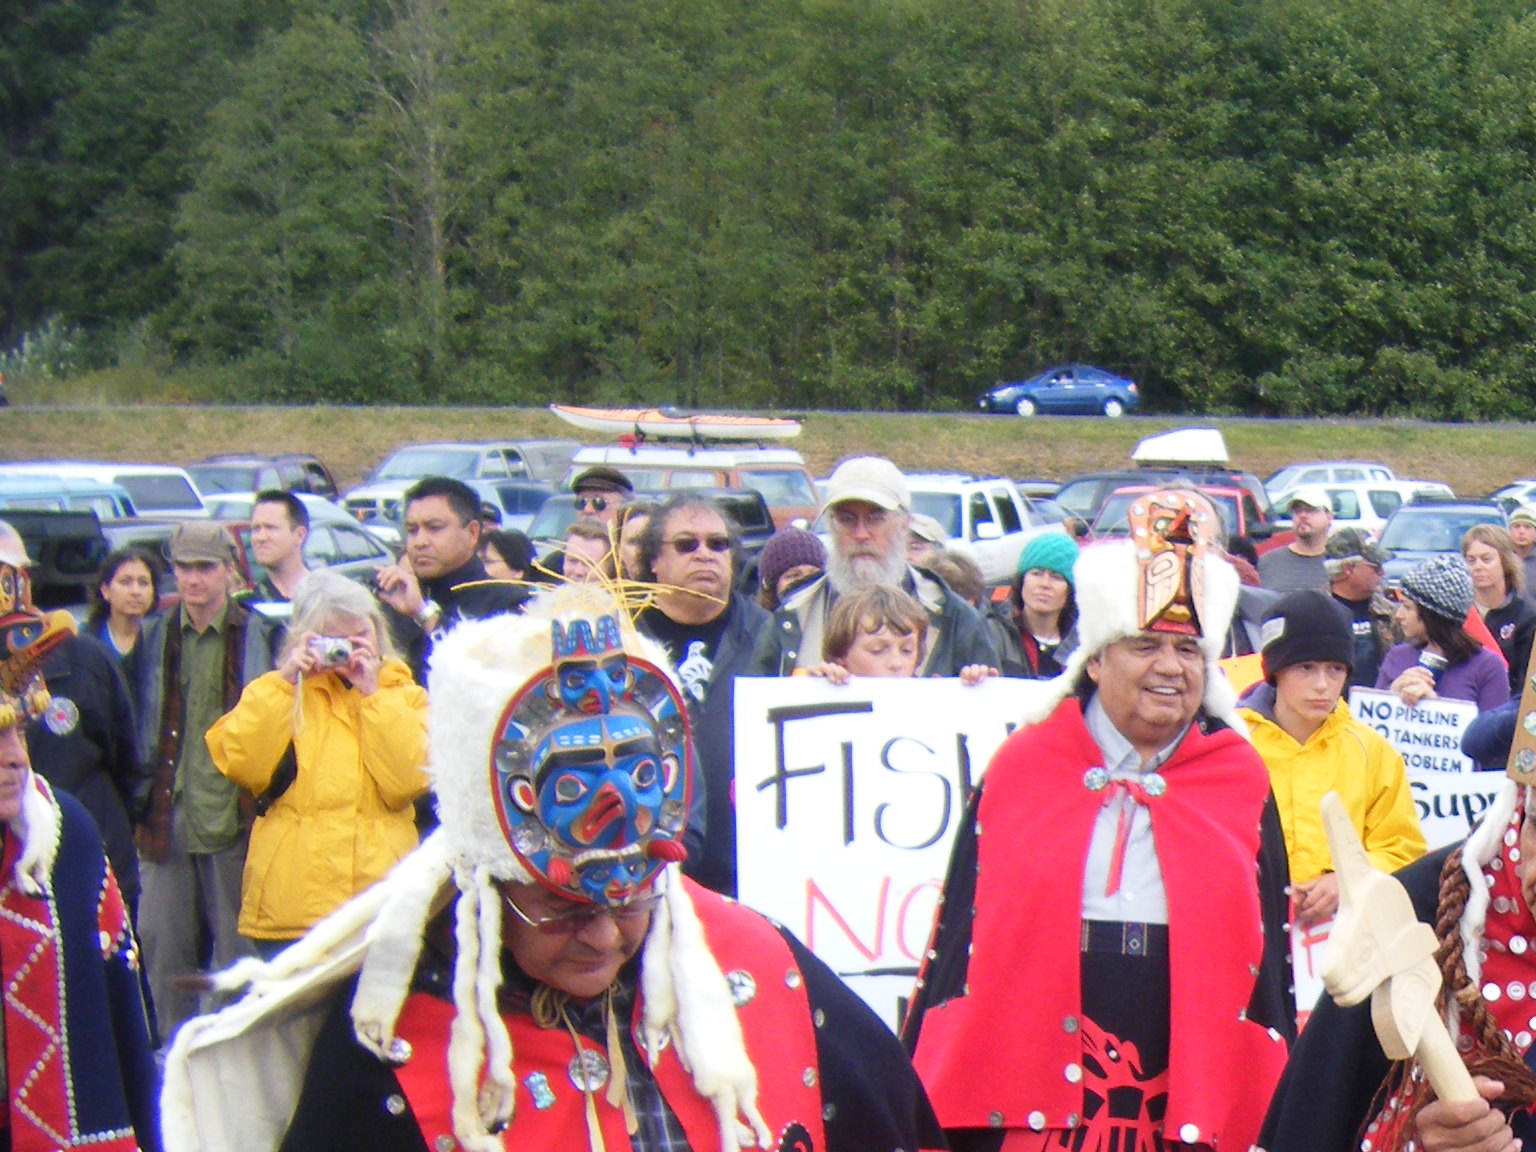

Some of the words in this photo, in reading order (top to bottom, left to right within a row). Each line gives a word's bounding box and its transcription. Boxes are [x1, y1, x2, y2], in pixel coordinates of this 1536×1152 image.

[1358, 699, 1393, 721] NO
[1394, 705, 1460, 727] PIPELINE
[1394, 728, 1460, 750] TANKERS
[1402, 752, 1462, 774] ROBLEM
